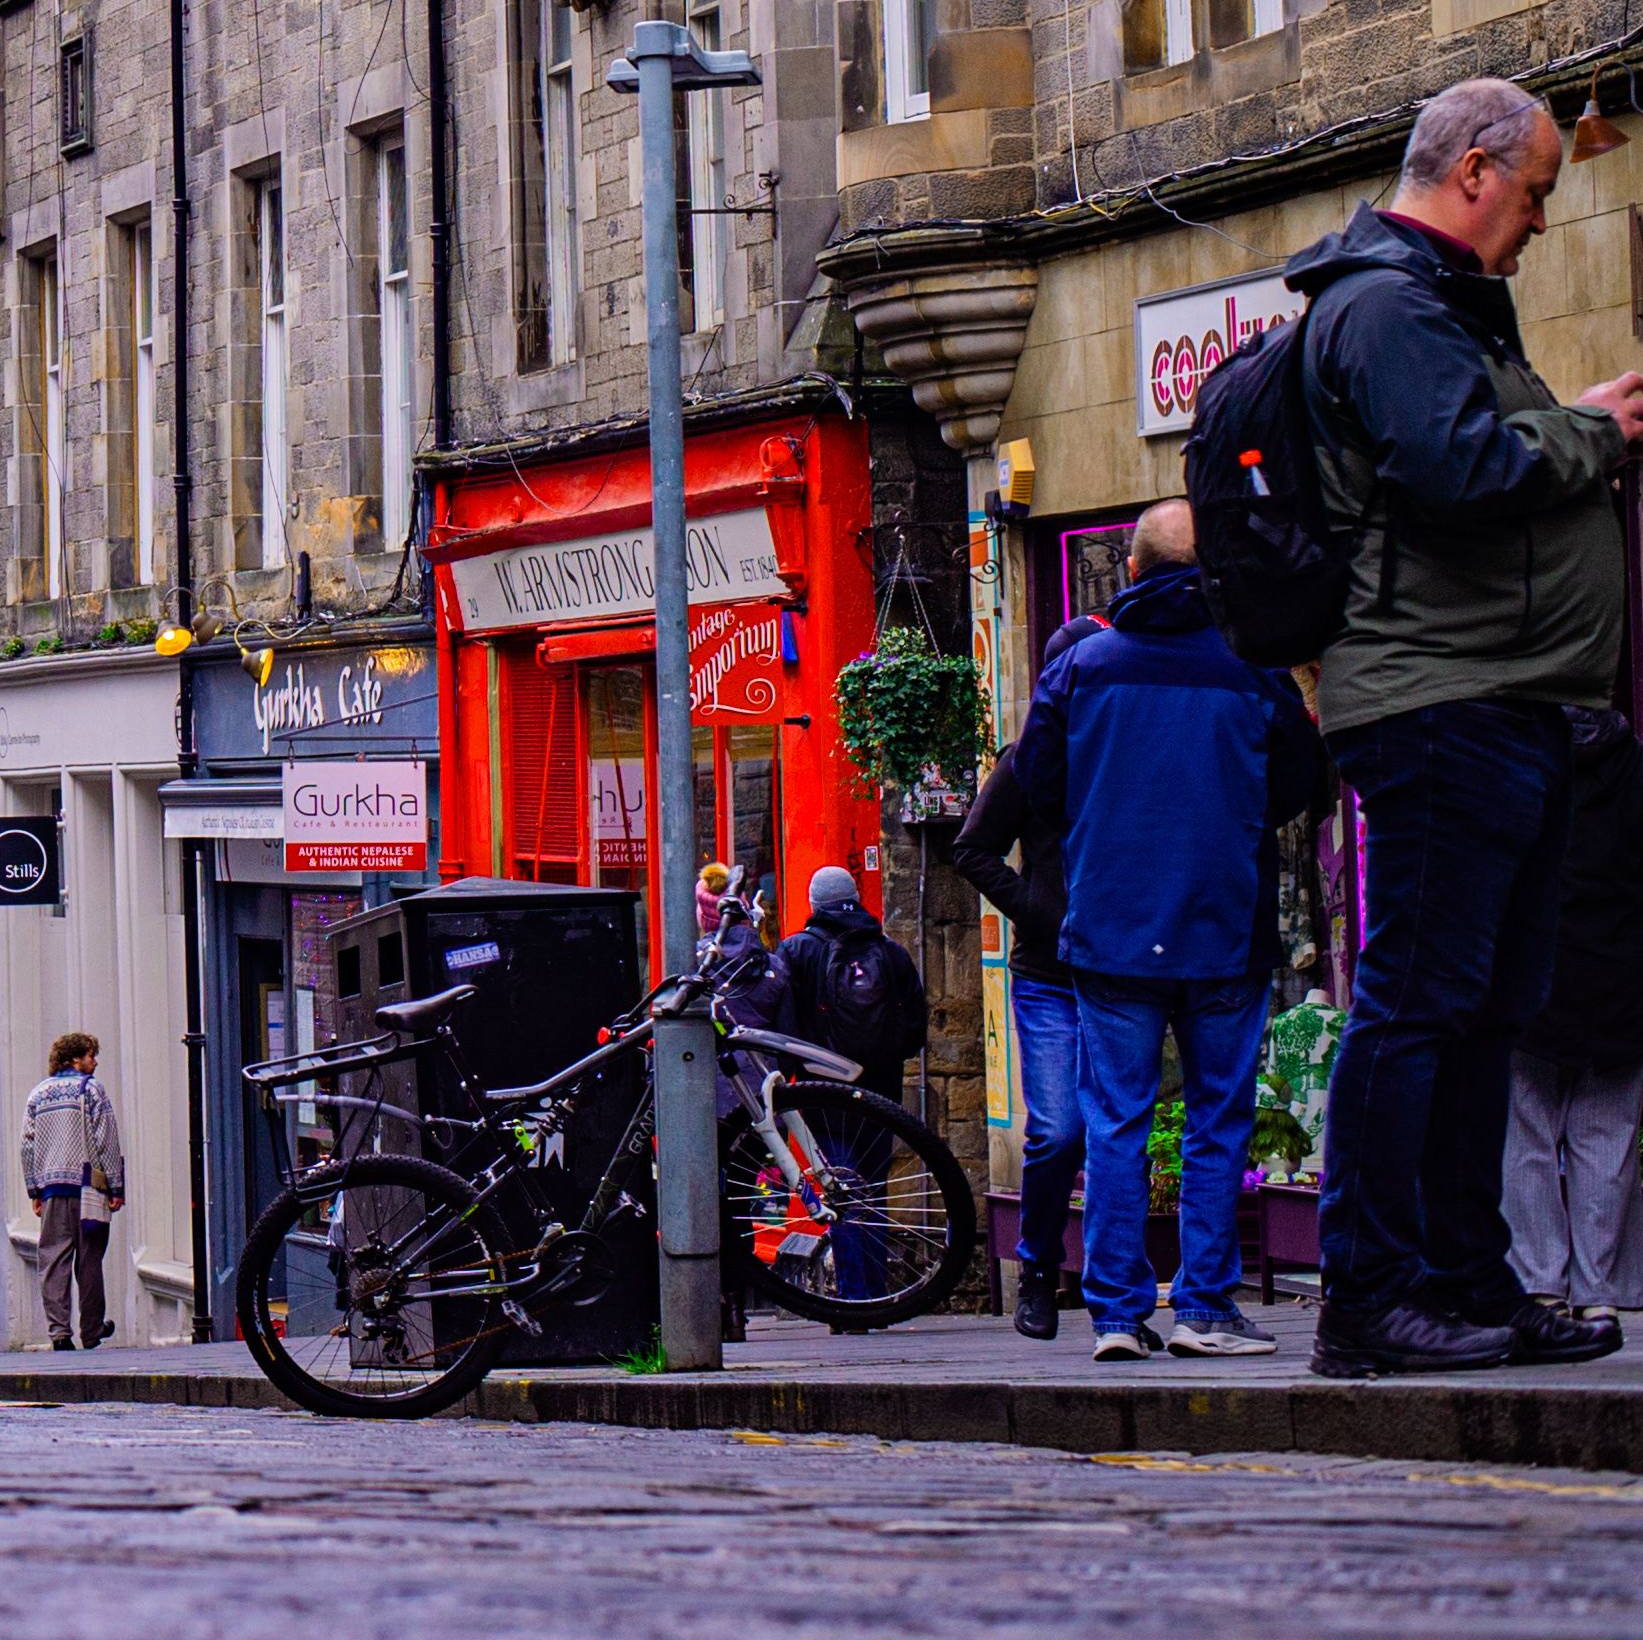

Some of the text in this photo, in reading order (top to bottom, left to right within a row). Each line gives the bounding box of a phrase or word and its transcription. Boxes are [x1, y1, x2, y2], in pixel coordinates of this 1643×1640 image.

[254, 656, 382, 757] Gurkha Cafe
[293, 783, 418, 817] Gurkha
[293, 820, 418, 828] Cafe & Restaurant
[298, 846, 414, 857] AUTHENTIC NEPALESE
[308, 857, 404, 867] & INDIAN CUISINE
[5, 863, 40, 879] Stills
